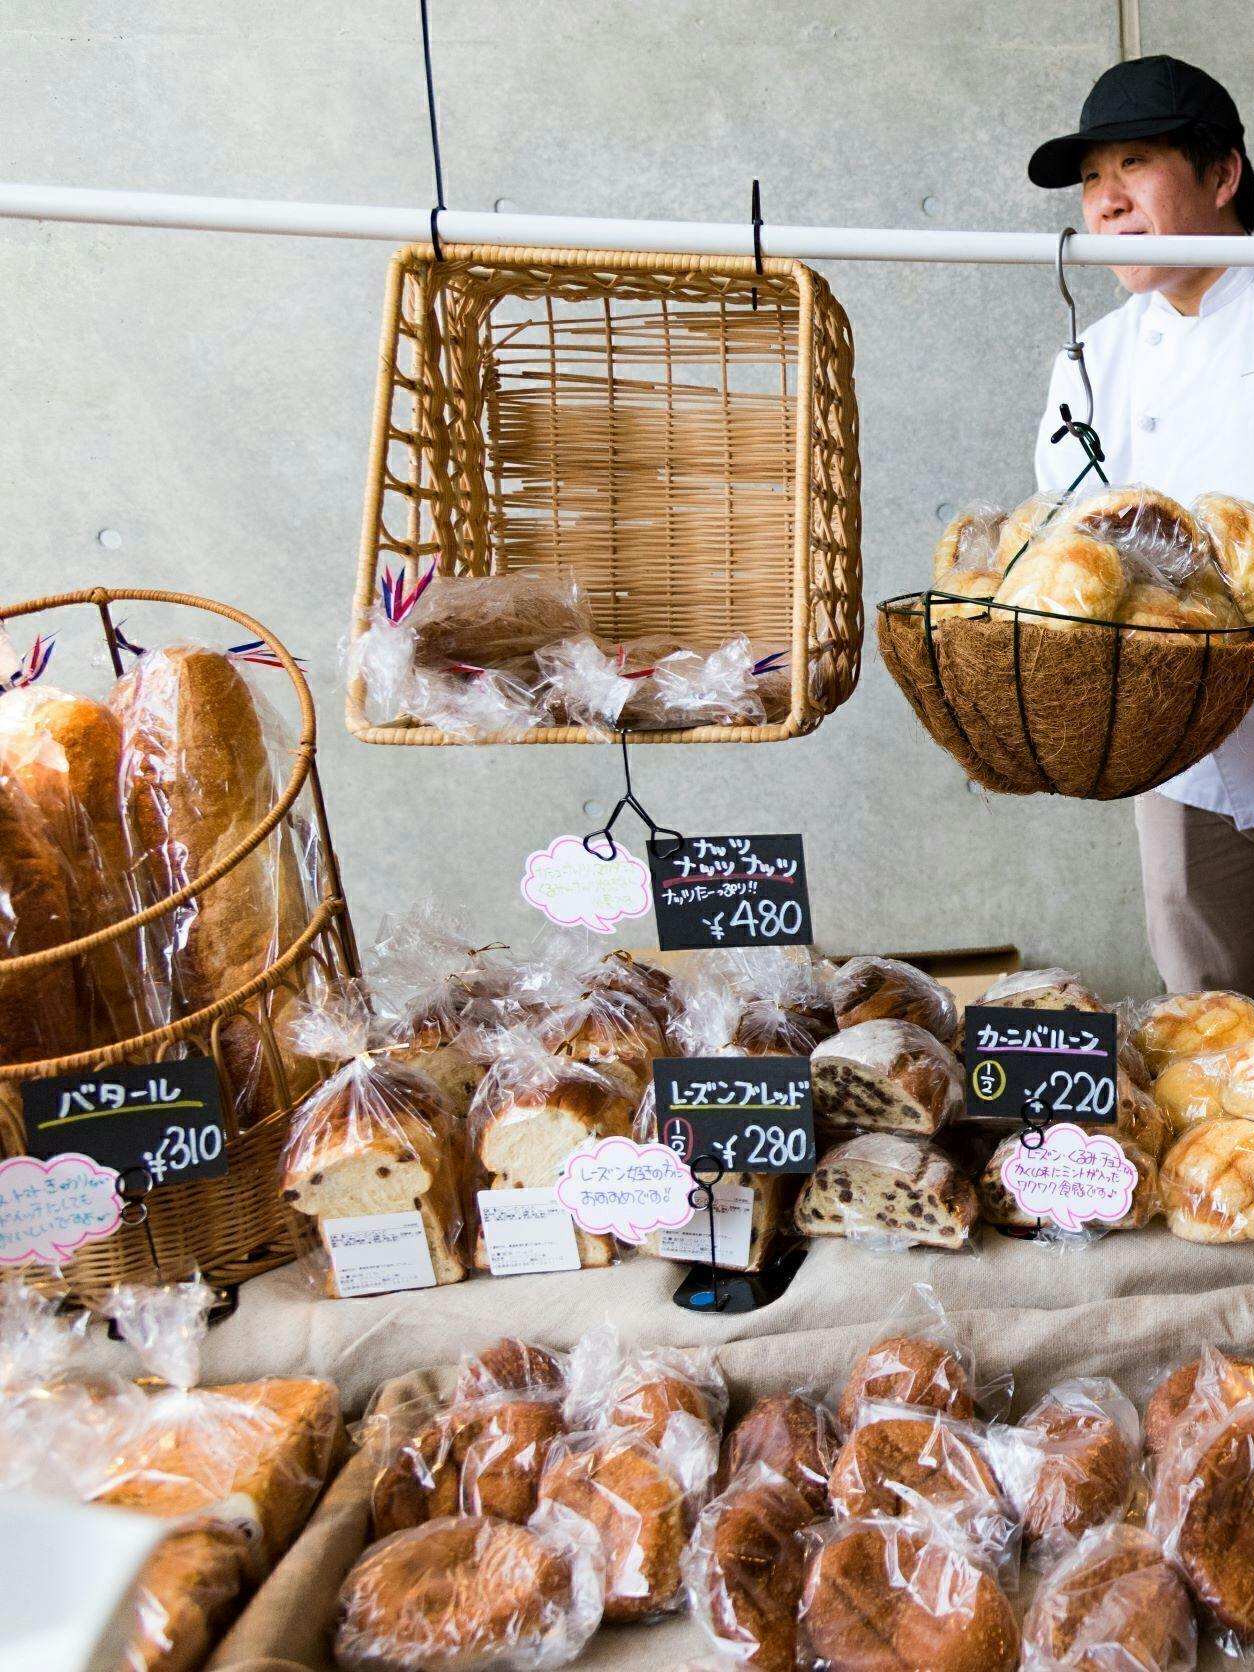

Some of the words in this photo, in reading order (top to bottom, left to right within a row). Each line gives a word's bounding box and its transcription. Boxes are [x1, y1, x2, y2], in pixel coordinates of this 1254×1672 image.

[702, 899, 803, 941] ¥480
[976, 1023, 1101, 1052] カーニバルーン
[58, 1078, 182, 1118] バタール
[671, 1080, 810, 1107] レーズンブレッド
[142, 1125, 223, 1183] ¥310
[711, 1125, 808, 1169] ¥280
